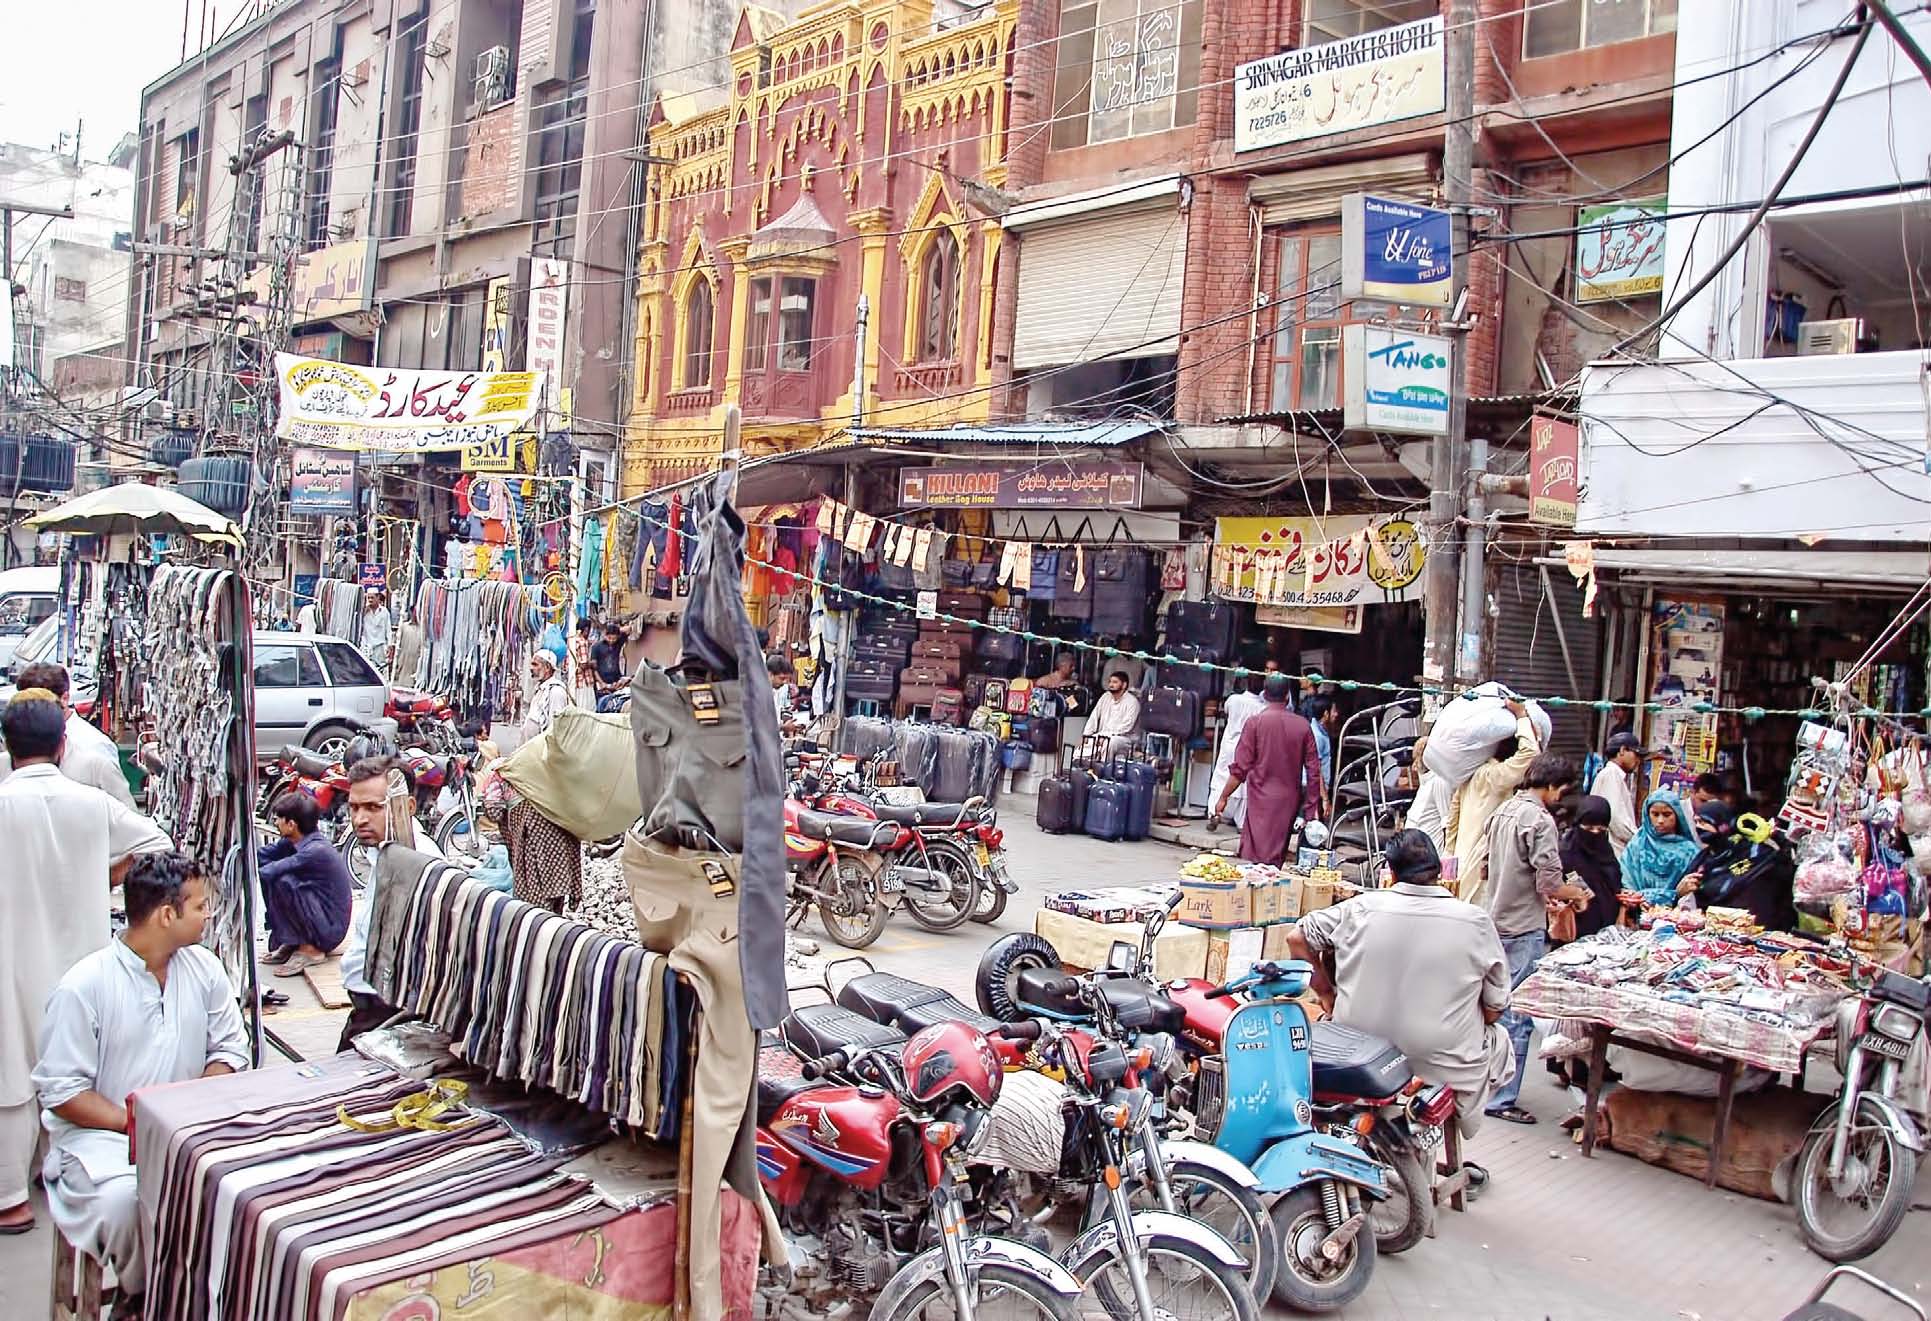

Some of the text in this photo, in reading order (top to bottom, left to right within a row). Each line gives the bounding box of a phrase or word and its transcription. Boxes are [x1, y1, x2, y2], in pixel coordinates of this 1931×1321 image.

[1245, 51, 1313, 91] SRINAGAR
[1249, 110, 1287, 132] 7225726
[1368, 340, 1447, 370] TANGO
[470, 458, 508, 467] Garments
[926, 471, 1000, 495] KILLANI
[1187, 897, 1213, 913] Lark
[1380, 1053, 1408, 1076] HONDA
